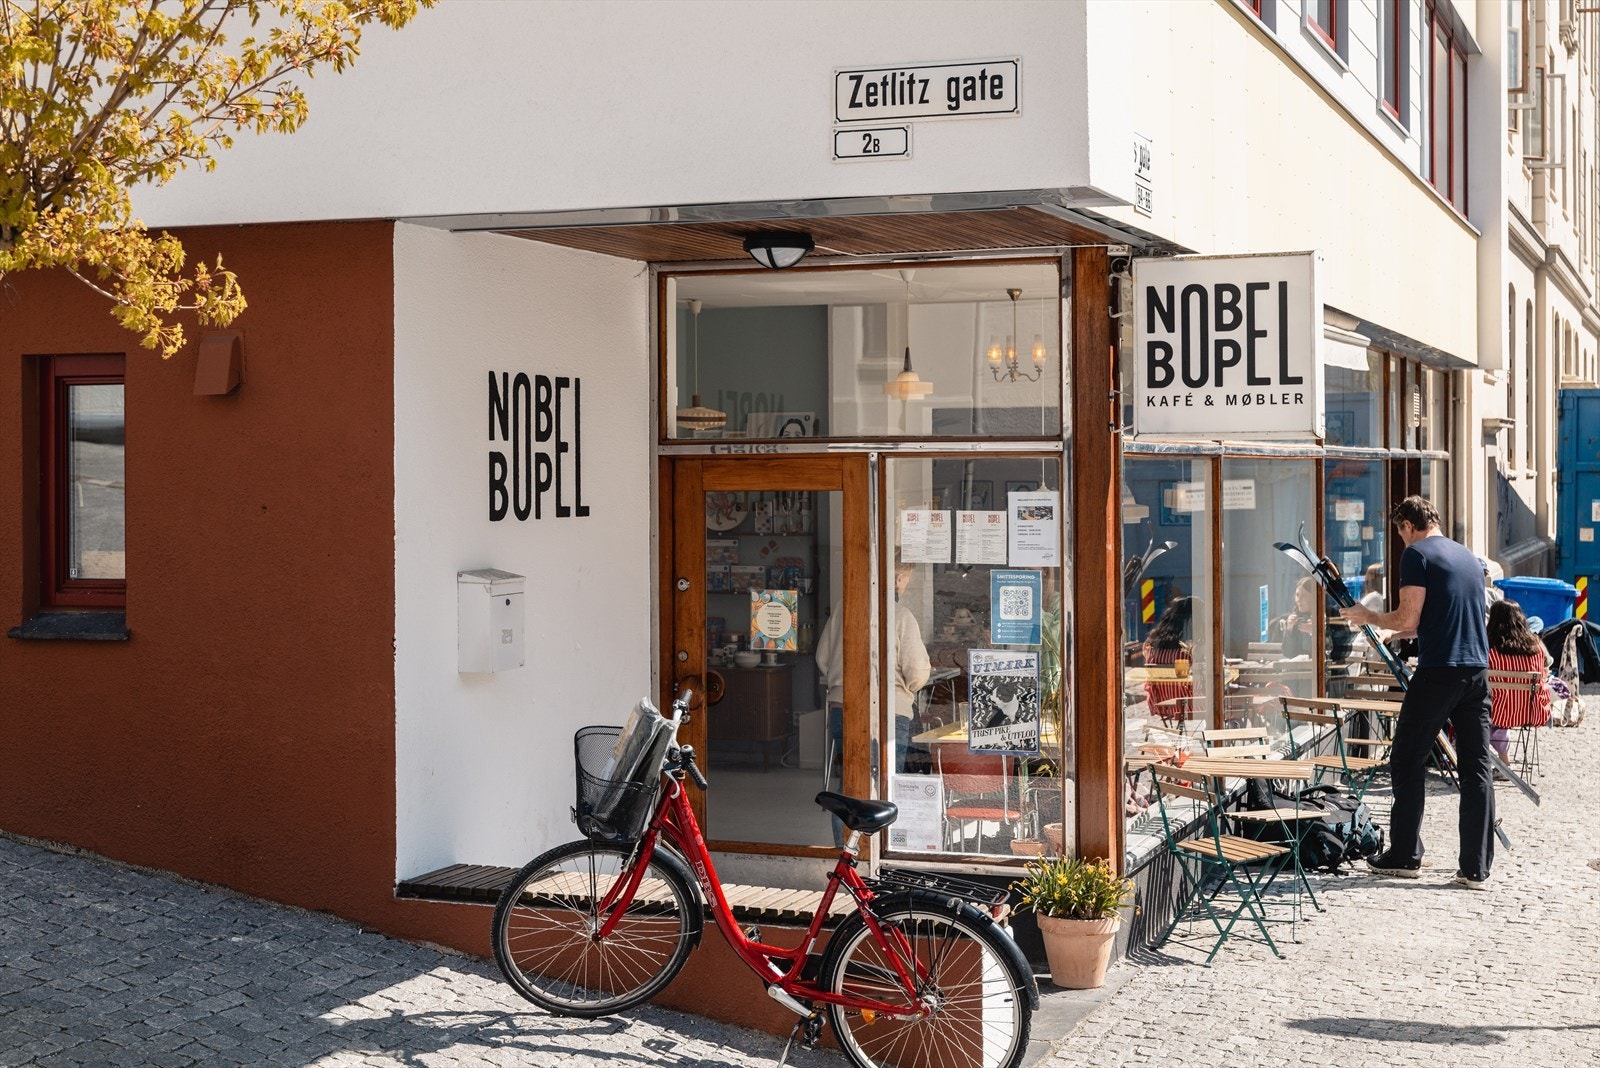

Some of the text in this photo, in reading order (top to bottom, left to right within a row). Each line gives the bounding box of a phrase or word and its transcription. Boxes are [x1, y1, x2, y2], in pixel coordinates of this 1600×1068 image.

[848, 68, 1004, 111] Zetlitz gate
[862, 133, 881, 153] 2B
[1146, 281, 1289, 337] NOBEL
[1146, 338, 1304, 389] BOPEL
[488, 371, 581, 449] NOBEL
[1146, 392, 1304, 407] KAFÉ & MØBLER
[488, 450, 590, 522] BOPEL
[972, 726, 1011, 738] TRIST PIKE
